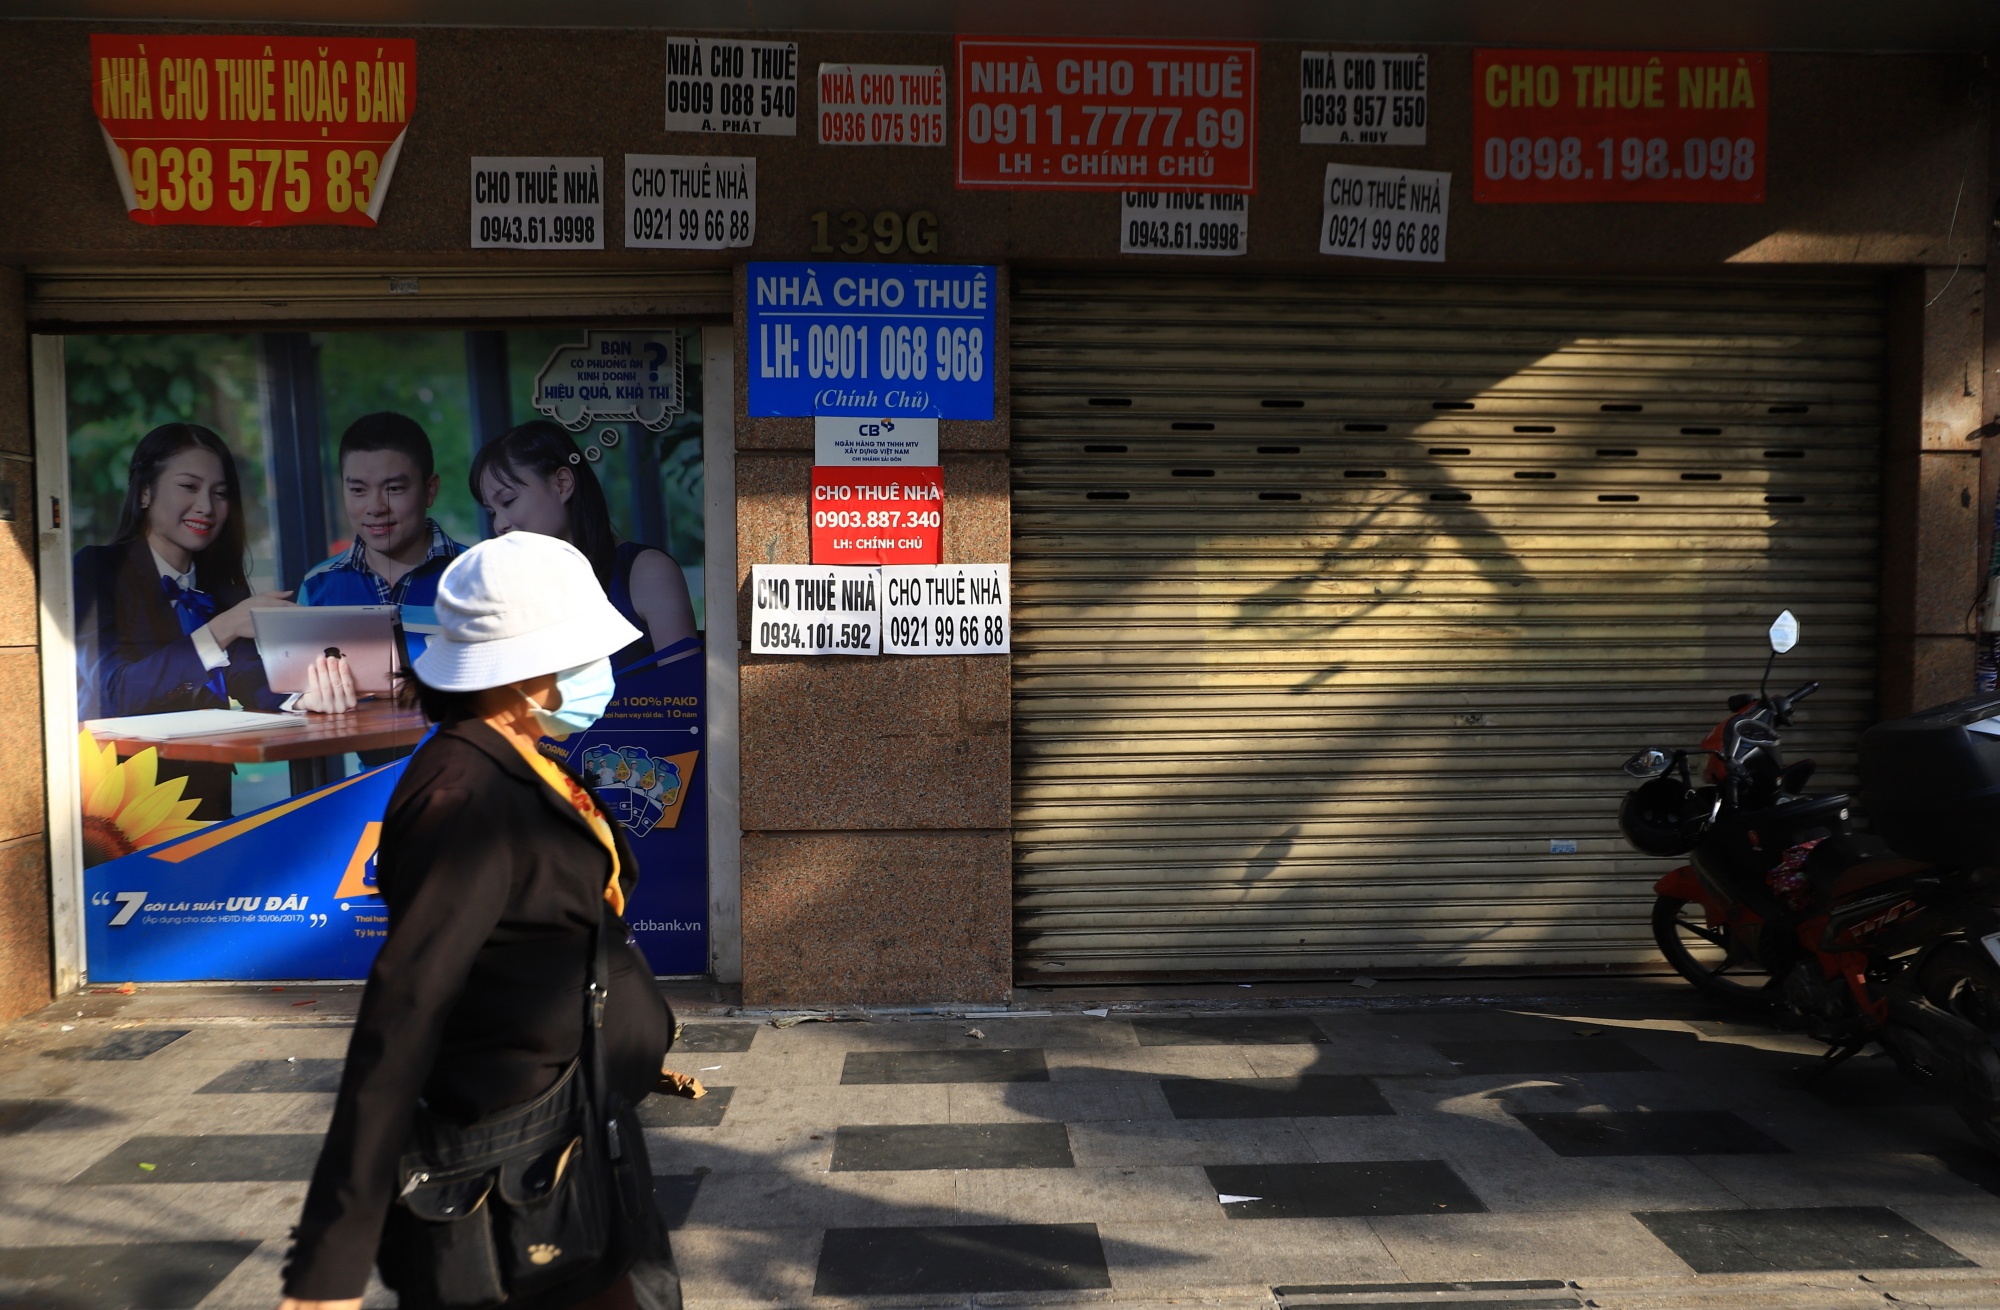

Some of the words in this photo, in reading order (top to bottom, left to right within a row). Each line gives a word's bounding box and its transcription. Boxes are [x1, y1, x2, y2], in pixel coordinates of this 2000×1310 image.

[668, 39, 702, 75] NHÀ
[711, 45, 743, 78] CHO
[752, 44, 795, 80] THUÊ
[1303, 53, 1336, 89] NHÀ
[1344, 59, 1375, 90] CHO
[1383, 55, 1425, 91] THUÊ
[101, 44, 153, 119] NHÀ
[160, 57, 208, 121] CHO
[215, 46, 276, 122] THUÊ
[284, 46, 348, 137] HOẶC
[357, 47, 405, 124] BÁN
[822, 67, 855, 104] NHÀ
[861, 74, 894, 105] CHO
[900, 65, 941, 105] THUÊ
[971, 55, 1043, 94] NHÀ
[1057, 59, 1134, 96] CHO
[1147, 55, 1243, 98] THUÊ
[1485, 64, 1560, 108] CHO
[1572, 57, 1664, 108] THUÊ
[1678, 58, 1755, 109] NHÀ
[668, 81, 713, 114] 0909
[721, 84, 753, 116] 088
[762, 85, 795, 118] 540
[1304, 94, 1347, 125] 0933
[1354, 96, 1386, 126] 957
[1394, 96, 1425, 127] 550
[702, 119, 716, 131] A.
[722, 119, 761, 133] PHÁT
[822, 112, 865, 142] 0936
[872, 113, 903, 142] 075
[910, 114, 941, 143] 915
[968, 103, 1244, 149] 0911.7777.69
[1340, 131, 1354, 142] A.
[1360, 131, 1387, 143] HUY
[999, 153, 1032, 173] LH
[1061, 150, 1147, 175] CHÍNH
[1158, 150, 1214, 177] CHỦ
[1484, 137, 1755, 181] 0898.198.098
[117, 147, 213, 211] 938
[228, 149, 310, 213] 575
[476, 171, 510, 203] CHO
[516, 165, 557, 204] THUÊ
[564, 165, 599, 204] NHÀ
[632, 168, 665, 196] CHO
[670, 162, 710, 198] THUÊ
[716, 164, 748, 199] NHÀ
[1331, 178, 1363, 206] CHO
[1368, 176, 1406, 210] THUÊ
[1410, 179, 1440, 214] NHÀ
[480, 216, 594, 243] 0943.61.9998
[634, 208, 671, 239] 0921
[679, 209, 698, 241] 99
[705, 209, 724, 241] 66
[730, 210, 749, 241] 88
[810, 210, 939, 255] 139G
[1129, 221, 1238, 248] 0943.61.9998
[1329, 215, 1367, 248] 0921
[1373, 219, 1391, 250] 99
[1397, 222, 1415, 253] 66
[1420, 224, 1440, 255] 88
[757, 268, 823, 306] NHÀ
[833, 277, 904, 308] CHO
[914, 272, 986, 309] THUÊ
[601, 341, 631, 358] BẠN
[761, 323, 799, 378] LH:
[808, 324, 868, 379] 0901
[880, 325, 927, 380] 068
[936, 326, 983, 382] 968
[545, 383, 574, 402] HIỆU
[579, 382, 611, 400] QUẢ,
[616, 382, 643, 399] KHẢ
[648, 386, 669, 399] THI
[577, 372, 599, 381] KINH
[603, 372, 636, 381] DOANH
[814, 389, 877, 410] (Chính
[884, 390, 929, 412] Chủ)
[859, 424, 880, 436] CB
[879, 447, 893, 455] VIỆT
[815, 485, 851, 501] CHO
[855, 482, 900, 501] THUÊ
[904, 482, 940, 501] NHÀ
[815, 511, 940, 528] 0903.887.340
[833, 538, 853, 549] LH:
[856, 535, 895, 549] CHÍNH
[898, 535, 923, 549] CHỦ
[757, 578, 789, 610] CHO
[795, 573, 836, 611] THUÊ
[842, 573, 876, 612] NHÀ
[889, 578, 921, 606] CHO
[925, 571, 965, 606] THUÊ
[971, 570, 1002, 605] NHÀ
[760, 621, 871, 649] 0934.101.592
[891, 616, 928, 647] 0921
[935, 616, 954, 647] 99
[960, 615, 979, 646] 66
[984, 615, 1003, 646] 88
[623, 697, 661, 707] 100%
[664, 697, 698, 707] PAKD
[667, 709, 681, 718] 10
[144, 902, 165, 912] GÓI
[168, 902, 189, 912] LÃI
[225, 896, 261, 912] ƯU
[264, 893, 309, 911] ĐÃI
[182, 915, 199, 923] cho
